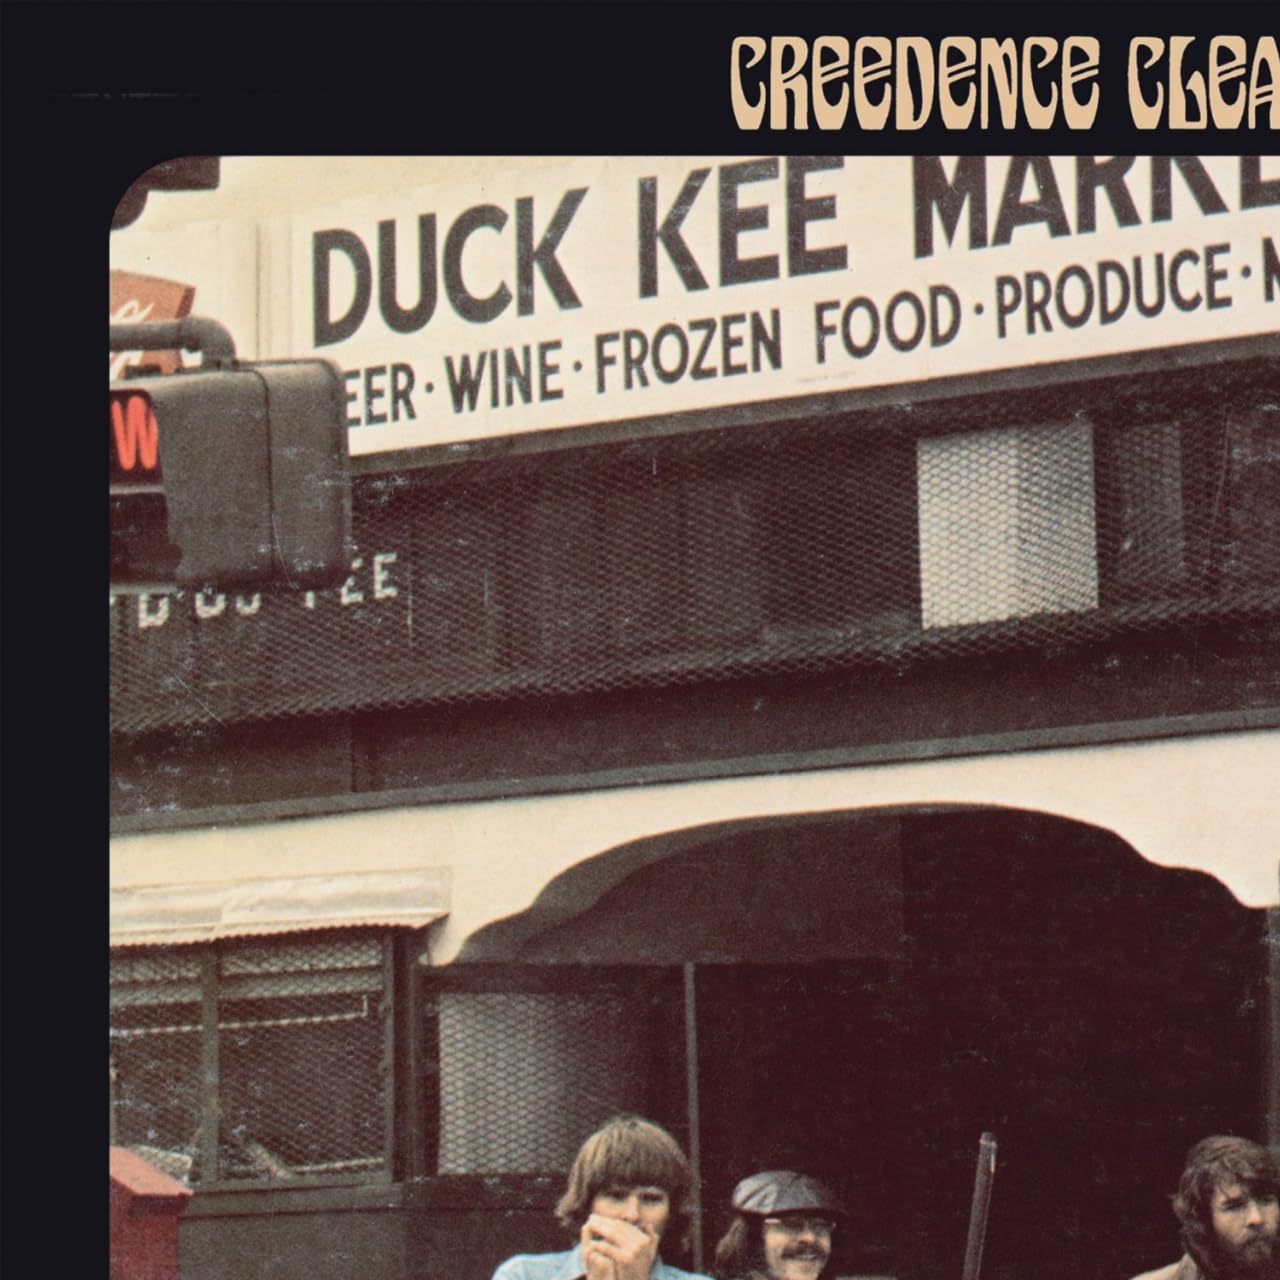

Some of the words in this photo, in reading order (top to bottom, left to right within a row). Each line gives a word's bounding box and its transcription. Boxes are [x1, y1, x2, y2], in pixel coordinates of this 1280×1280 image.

[312, 186, 590, 349] DUCK
[638, 156, 849, 299] KEE
[344, 363, 417, 428] EER
[444, 340, 564, 414] WINE
[595, 308, 783, 394] FROZEN
[814, 284, 962, 364] FOOD
[996, 242, 1233, 339] PRODUCE
